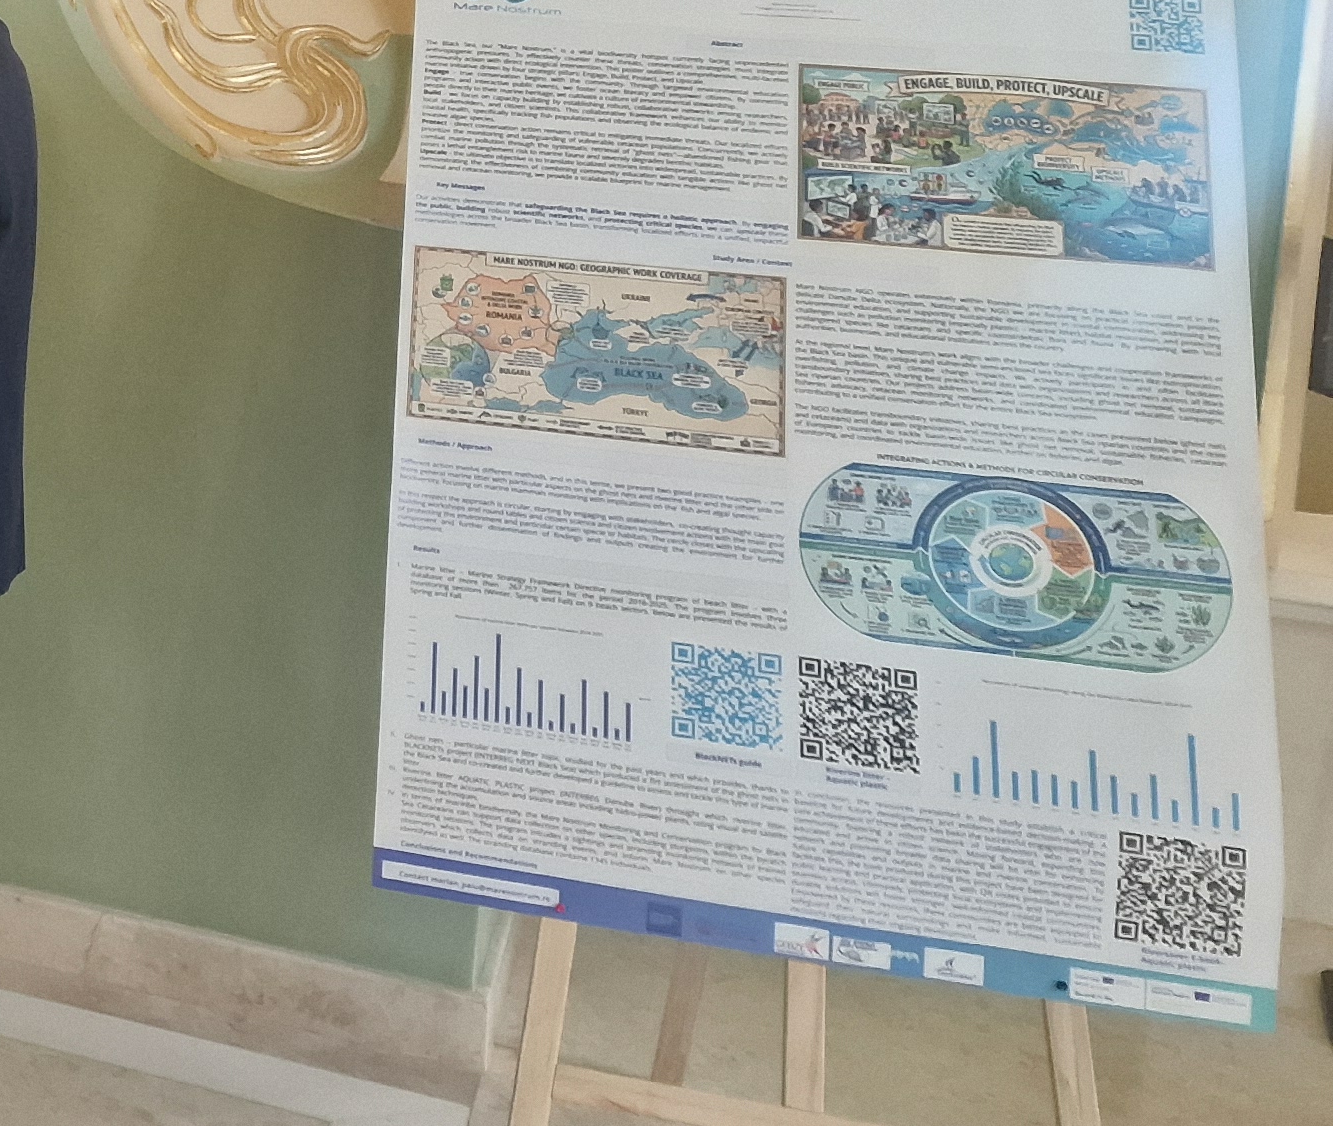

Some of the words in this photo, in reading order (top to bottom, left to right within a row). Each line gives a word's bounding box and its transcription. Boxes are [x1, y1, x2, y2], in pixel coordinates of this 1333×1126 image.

[453, 1, 494, 12] Mare
[496, 4, 562, 15] Nostrum
[903, 78, 954, 91] ENGAGE,
[955, 78, 994, 92] BUILD,
[996, 80, 1051, 96] PROTECT,
[1052, 84, 1105, 102] UPSCALE
[493, 256, 515, 266] MARE
[517, 258, 557, 269] NOSTRUM
[558, 261, 578, 271] NGO:
[580, 263, 631, 275] GEOGRAPHIC
[633, 268, 657, 277] WORK
[659, 270, 703, 282] COVERAGE
[485, 311, 523, 322] ROMANIA
[498, 367, 532, 377] BULGARIA
